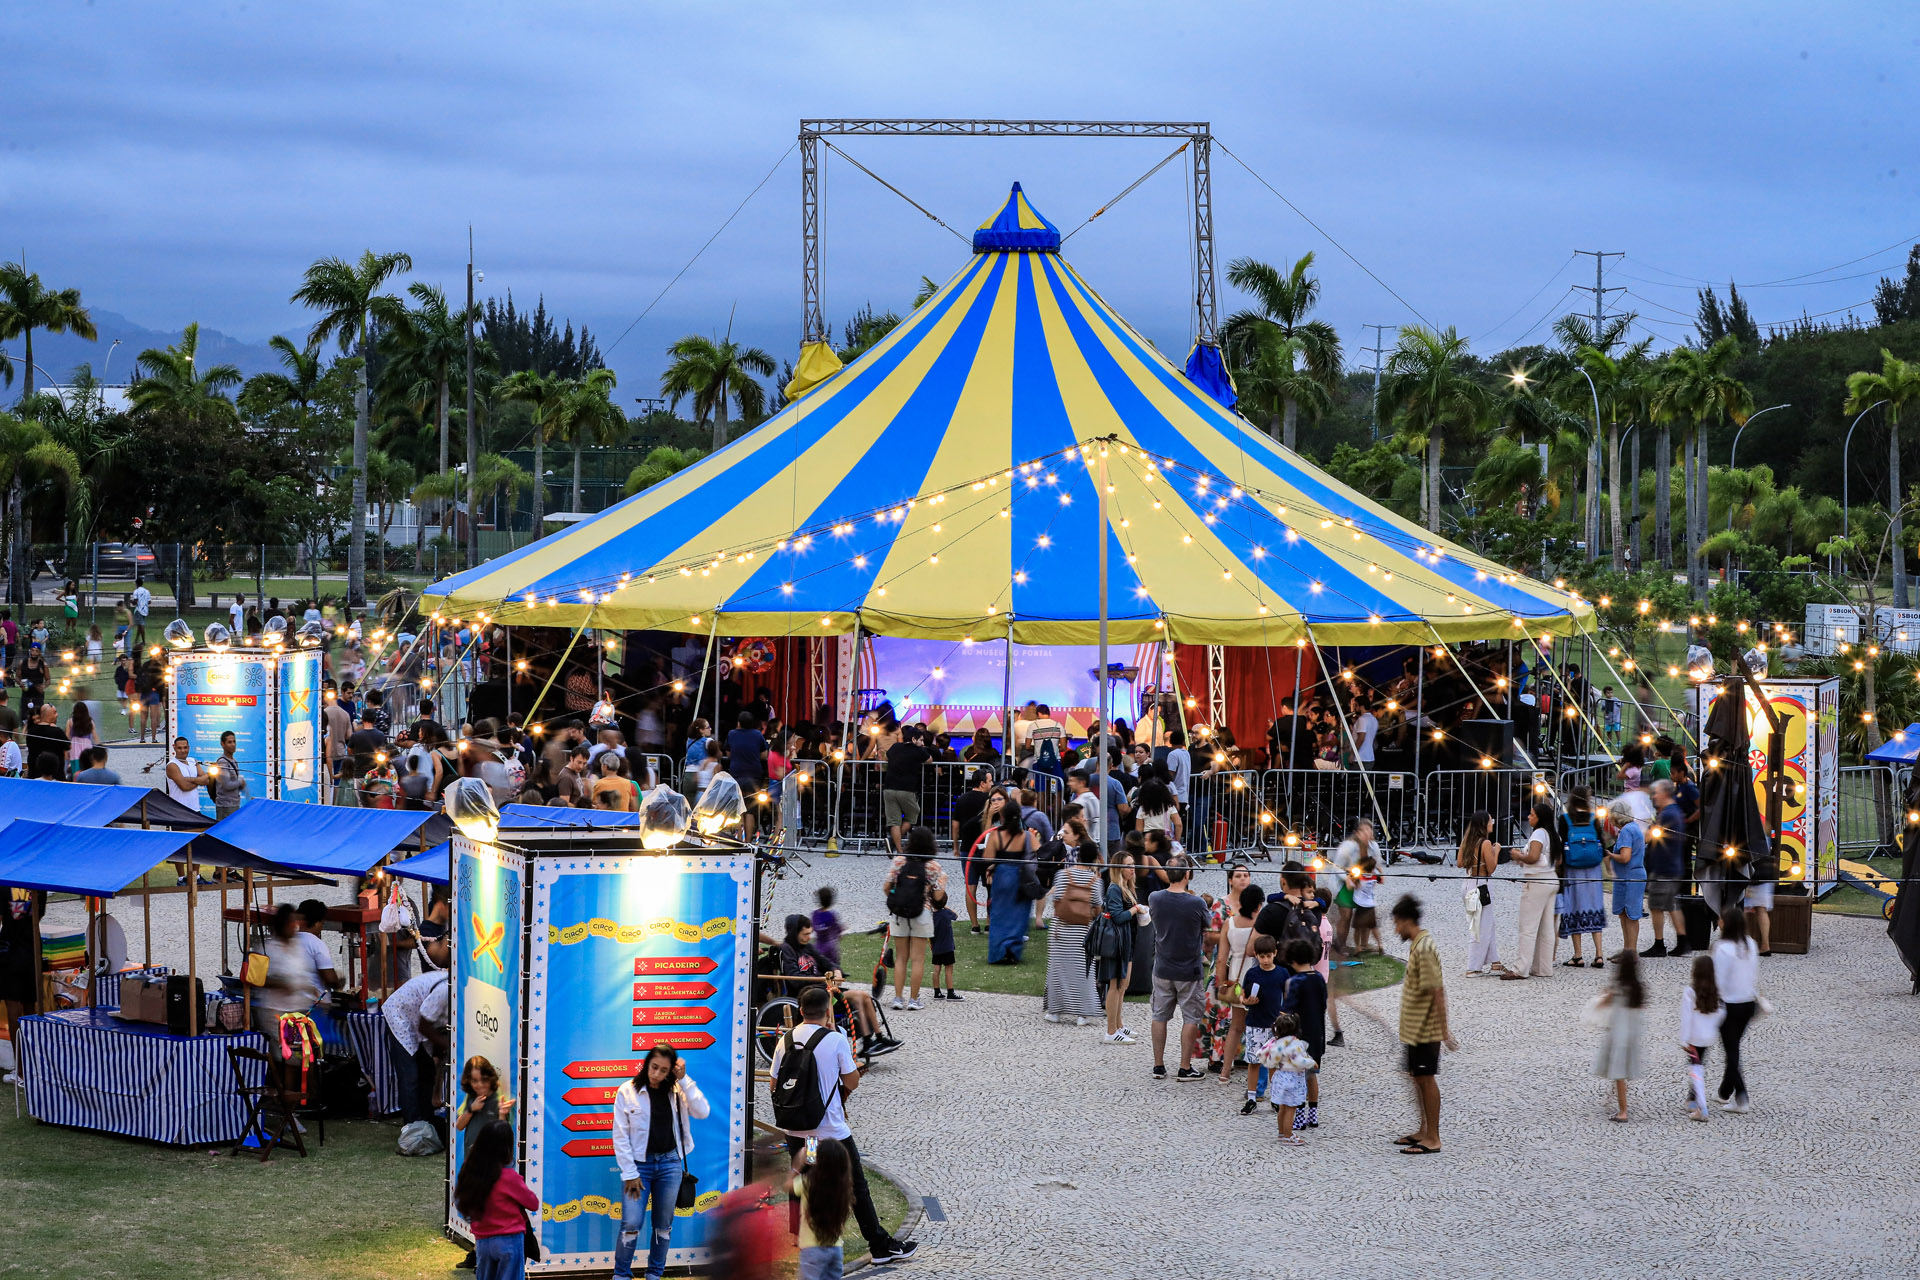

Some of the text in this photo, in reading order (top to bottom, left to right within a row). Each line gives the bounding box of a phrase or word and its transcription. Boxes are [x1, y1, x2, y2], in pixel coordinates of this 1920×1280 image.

[292, 736, 306, 746] CIRCO
[564, 927, 584, 939] CIRCO
[592, 923, 613, 932] CIRCO
[649, 922, 670, 930] CIRCO
[678, 927, 698, 937] CIRCO
[706, 921, 726, 933] CIRCO
[475, 1010, 499, 1033] CIRCO
[578, 1064, 628, 1072] EXPOSIÇÕES
[557, 1205, 577, 1216] CIRCO
[586, 1200, 607, 1209] CIRCO
[698, 1195, 718, 1207] CIRCO
